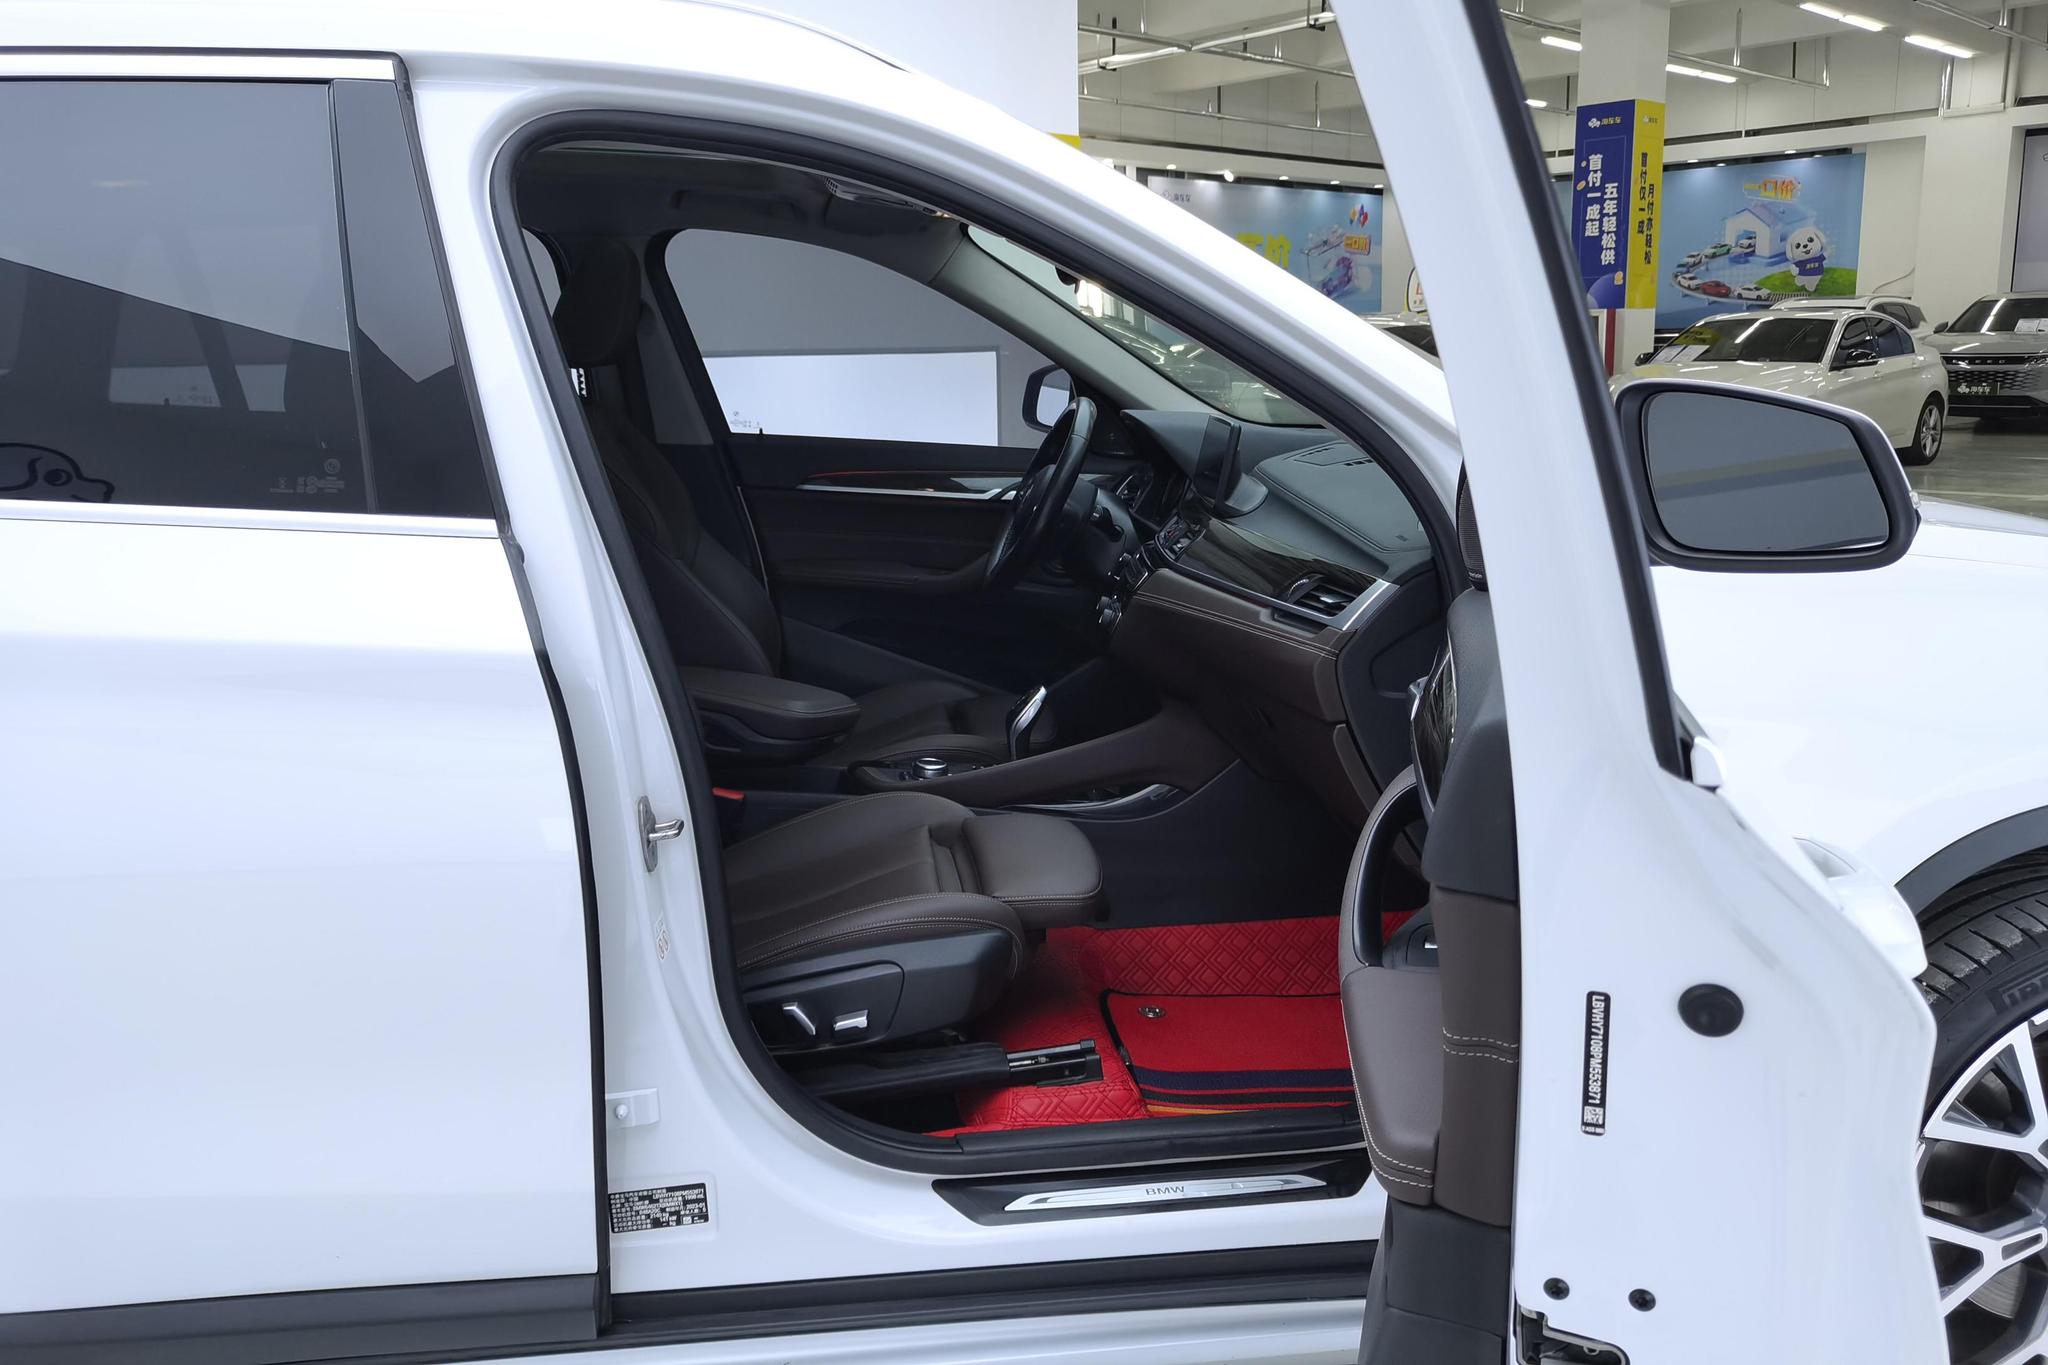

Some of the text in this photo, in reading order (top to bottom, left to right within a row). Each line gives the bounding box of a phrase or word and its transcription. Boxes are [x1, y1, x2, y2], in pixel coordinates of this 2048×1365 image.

[1585, 153, 1603, 237] 首付一成起
[1600, 182, 1619, 266] 五年轻松供
[1145, 1186, 1184, 1195] BMW
